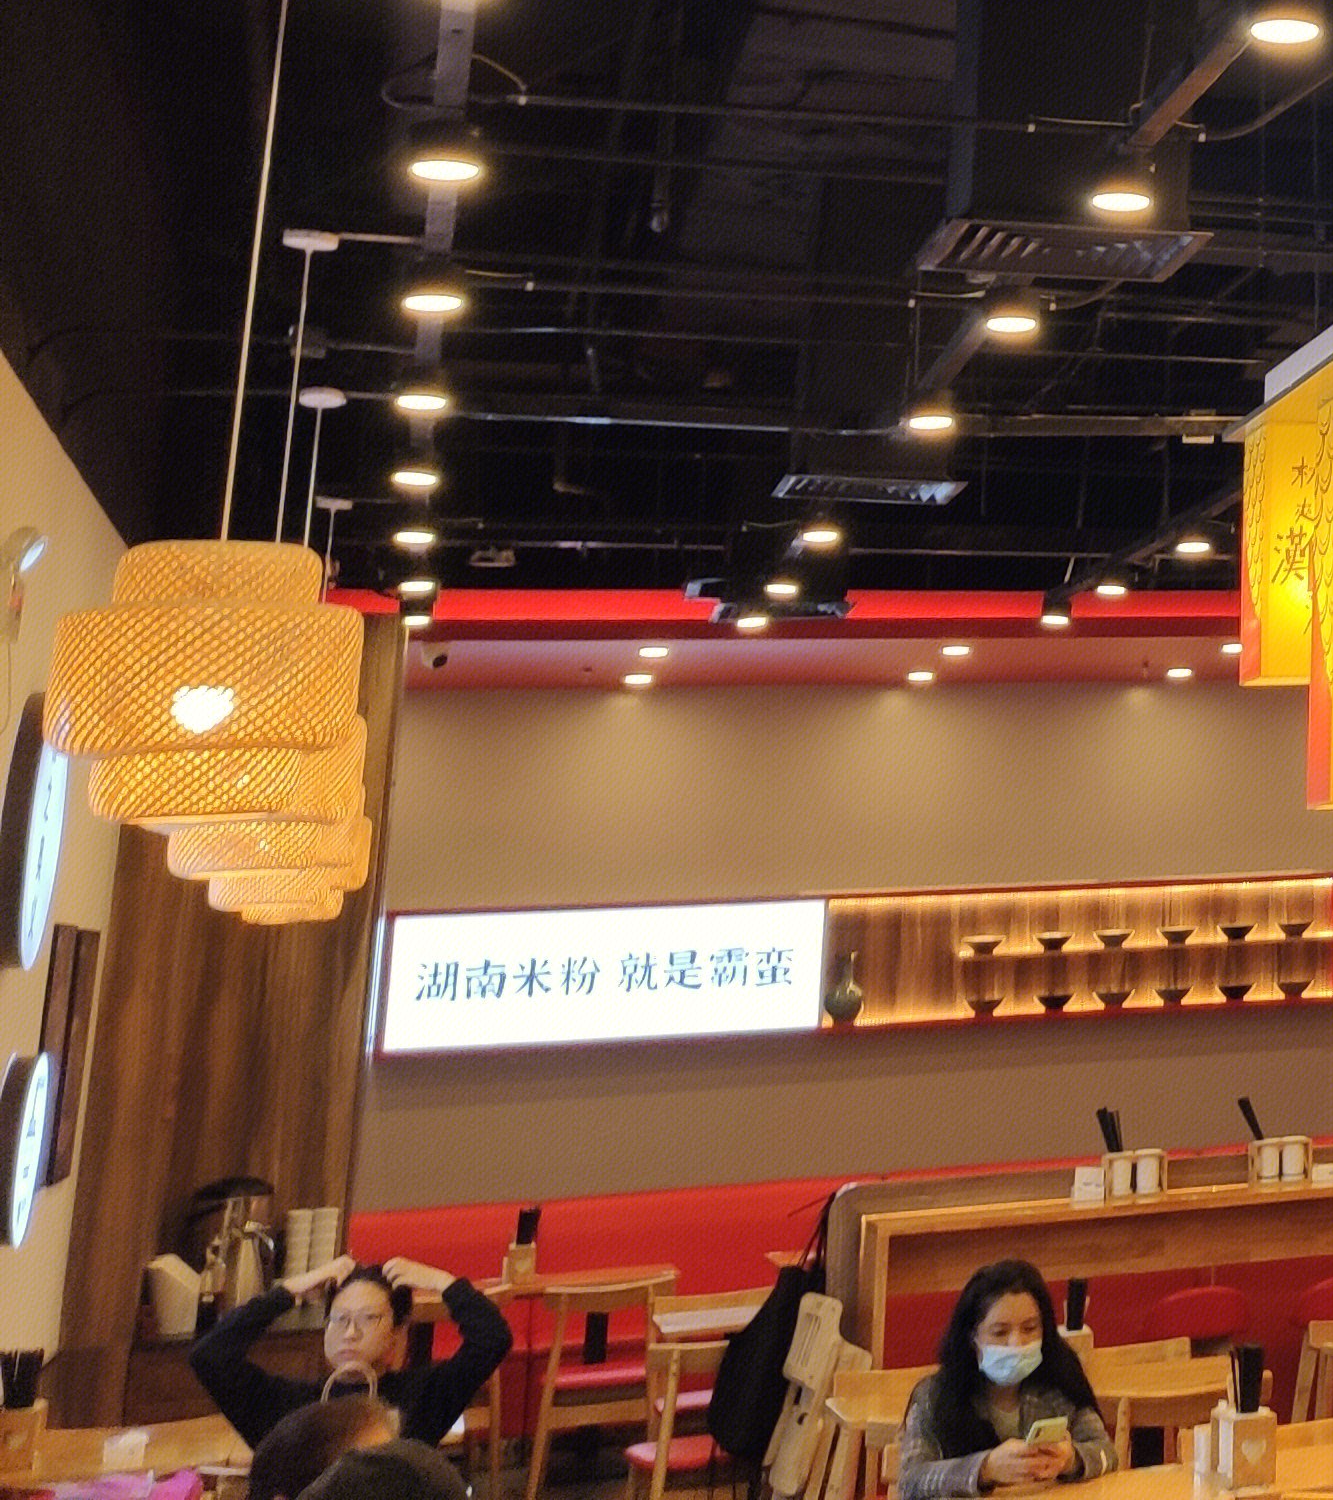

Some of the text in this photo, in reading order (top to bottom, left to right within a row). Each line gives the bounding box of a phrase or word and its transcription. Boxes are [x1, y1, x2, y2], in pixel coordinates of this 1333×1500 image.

[416, 946, 794, 1001] 湖南米粉 就是霸蛮
